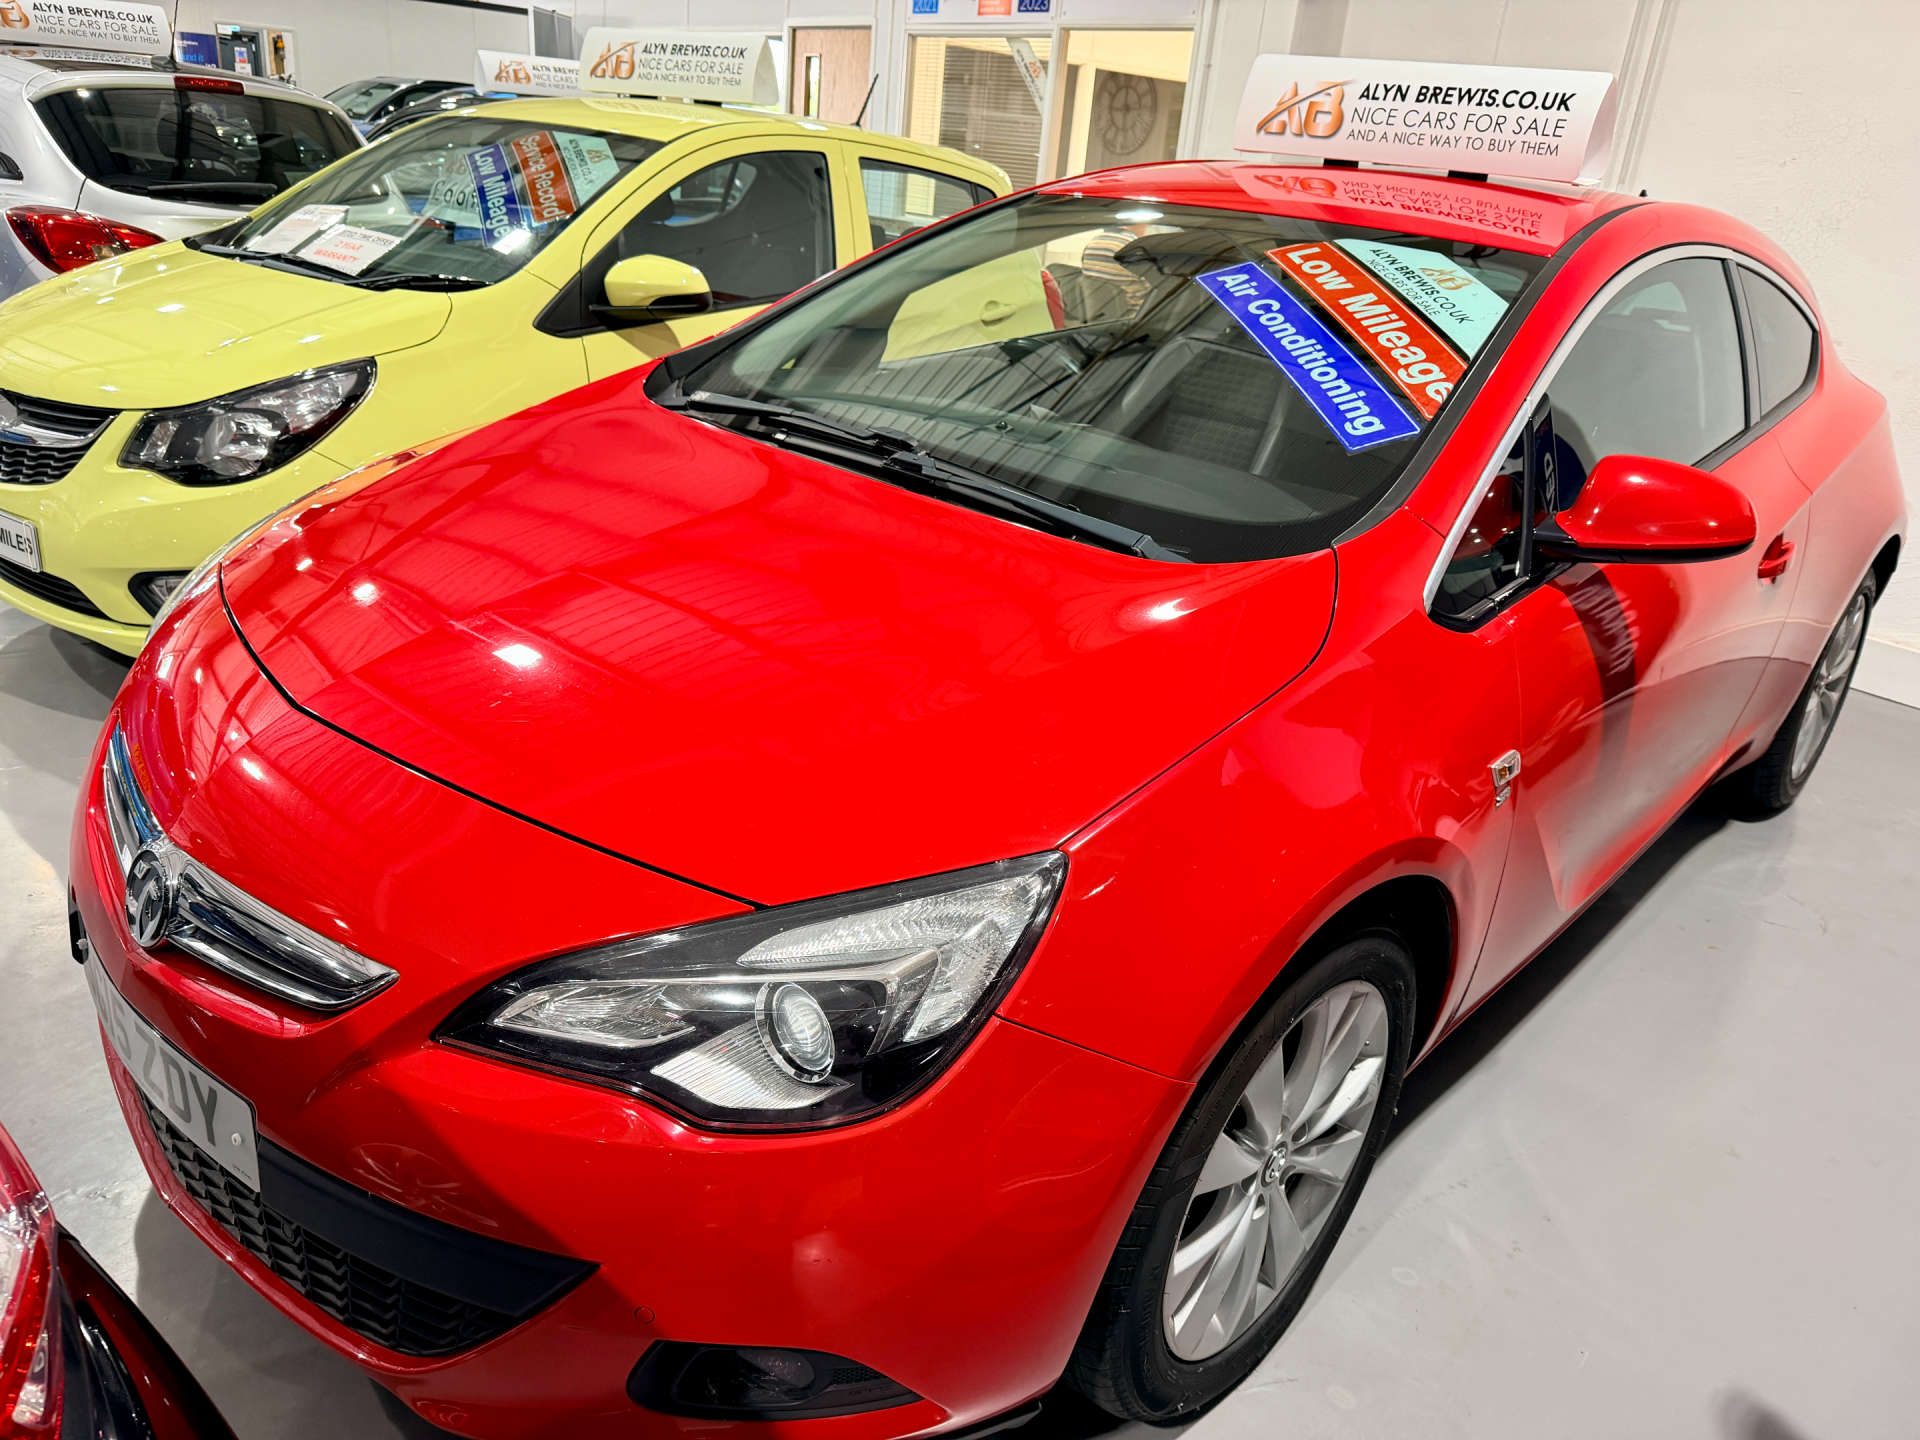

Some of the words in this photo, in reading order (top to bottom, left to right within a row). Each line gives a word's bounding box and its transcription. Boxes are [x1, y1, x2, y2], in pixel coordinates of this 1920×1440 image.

[32, 2, 63, 14] ALYN
[68, 6, 155, 24] BREWIS.CO.UK
[34, 14, 65, 27] NICE
[68, 18, 101, 30] CARS
[104, 23, 128, 33] FOR
[132, 26, 159, 36] SALE
[38, 26, 56, 34] AND
[89, 31, 108, 40] WAY
[110, 33, 121, 41] TO
[123, 35, 138, 43] BUY
[139, 36, 160, 45] THEM
[642, 42, 668, 54] ALYN
[670, 43, 748, 59] BREWIS.CO.UK
[638, 58, 662, 71] NICE
[664, 59, 692, 72] CARS
[694, 61, 716, 74] FOR
[717, 62, 744, 75] SALE
[638, 72, 652, 81] AND
[654, 73, 659, 81] A
[661, 74, 677, 83] NICE
[678, 74, 694, 84] WAY
[696, 76, 706, 84] TO
[706, 76, 721, 86] BUY
[722, 77, 742, 86] THEM
[1358, 82, 1411, 103] ALYN
[1414, 85, 1577, 112] BREWIS.CO.UK
[1351, 106, 1399, 127] NICE
[1403, 109, 1458, 132] CARS
[1463, 113, 1507, 135] FOR
[1512, 116, 1567, 138] SALE
[520, 134, 547, 172] Service
[1346, 129, 1377, 142] AND
[1378, 131, 1389, 143] A
[1393, 132, 1426, 146] NICE
[1430, 134, 1462, 149] WAY
[1466, 136, 1484, 151] TO
[1488, 138, 1517, 154] BUY
[1520, 140, 1560, 157] THEM
[474, 148, 497, 176] Low
[482, 174, 513, 238] Mileage
[533, 170, 566, 219] Record
[1368, 258, 1386, 273] NICE
[1384, 269, 1408, 289] CARS
[1404, 286, 1422, 305] FOR
[1418, 300, 1441, 317] SALE
[1370, 248, 1402, 266] ALYN
[1394, 266, 1475, 324] BREWIS.CO.UK
[1286, 246, 1356, 294] Low
[1337, 292, 1454, 404] Mileage
[1216, 273, 1259, 298] Air
[1247, 298, 1386, 437] Conditioning
[135, 1020, 218, 1147] ZDY
